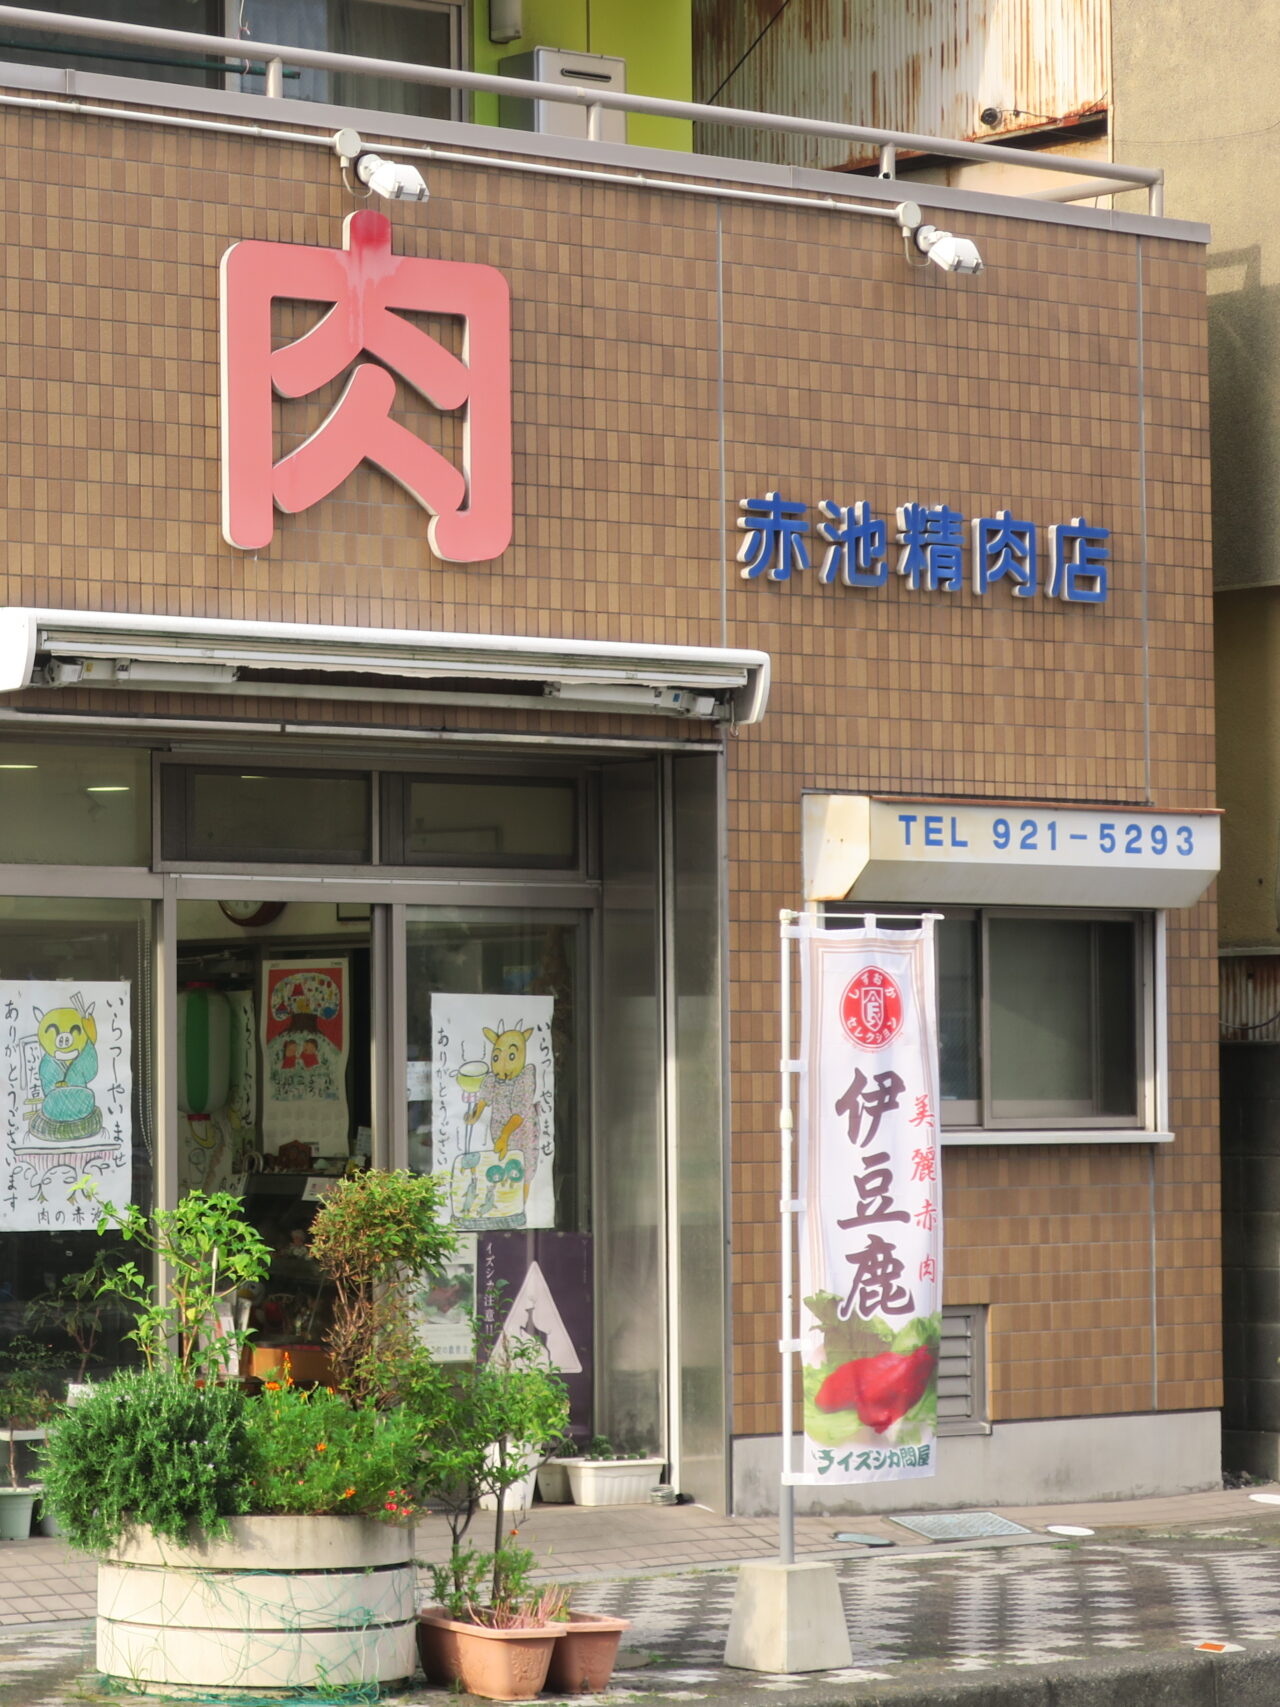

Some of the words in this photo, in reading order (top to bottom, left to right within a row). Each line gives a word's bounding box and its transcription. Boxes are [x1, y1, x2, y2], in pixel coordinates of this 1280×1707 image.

[219, 209, 513, 564] 肉
[736, 490, 1111, 605] 赤池精肉店
[898, 814, 969, 847] TEL
[992, 818, 1195, 856] 921-5293
[835, 1067, 915, 1317] 伊豆鹿
[909, 1094, 937, 1283] 美麗赤肉
